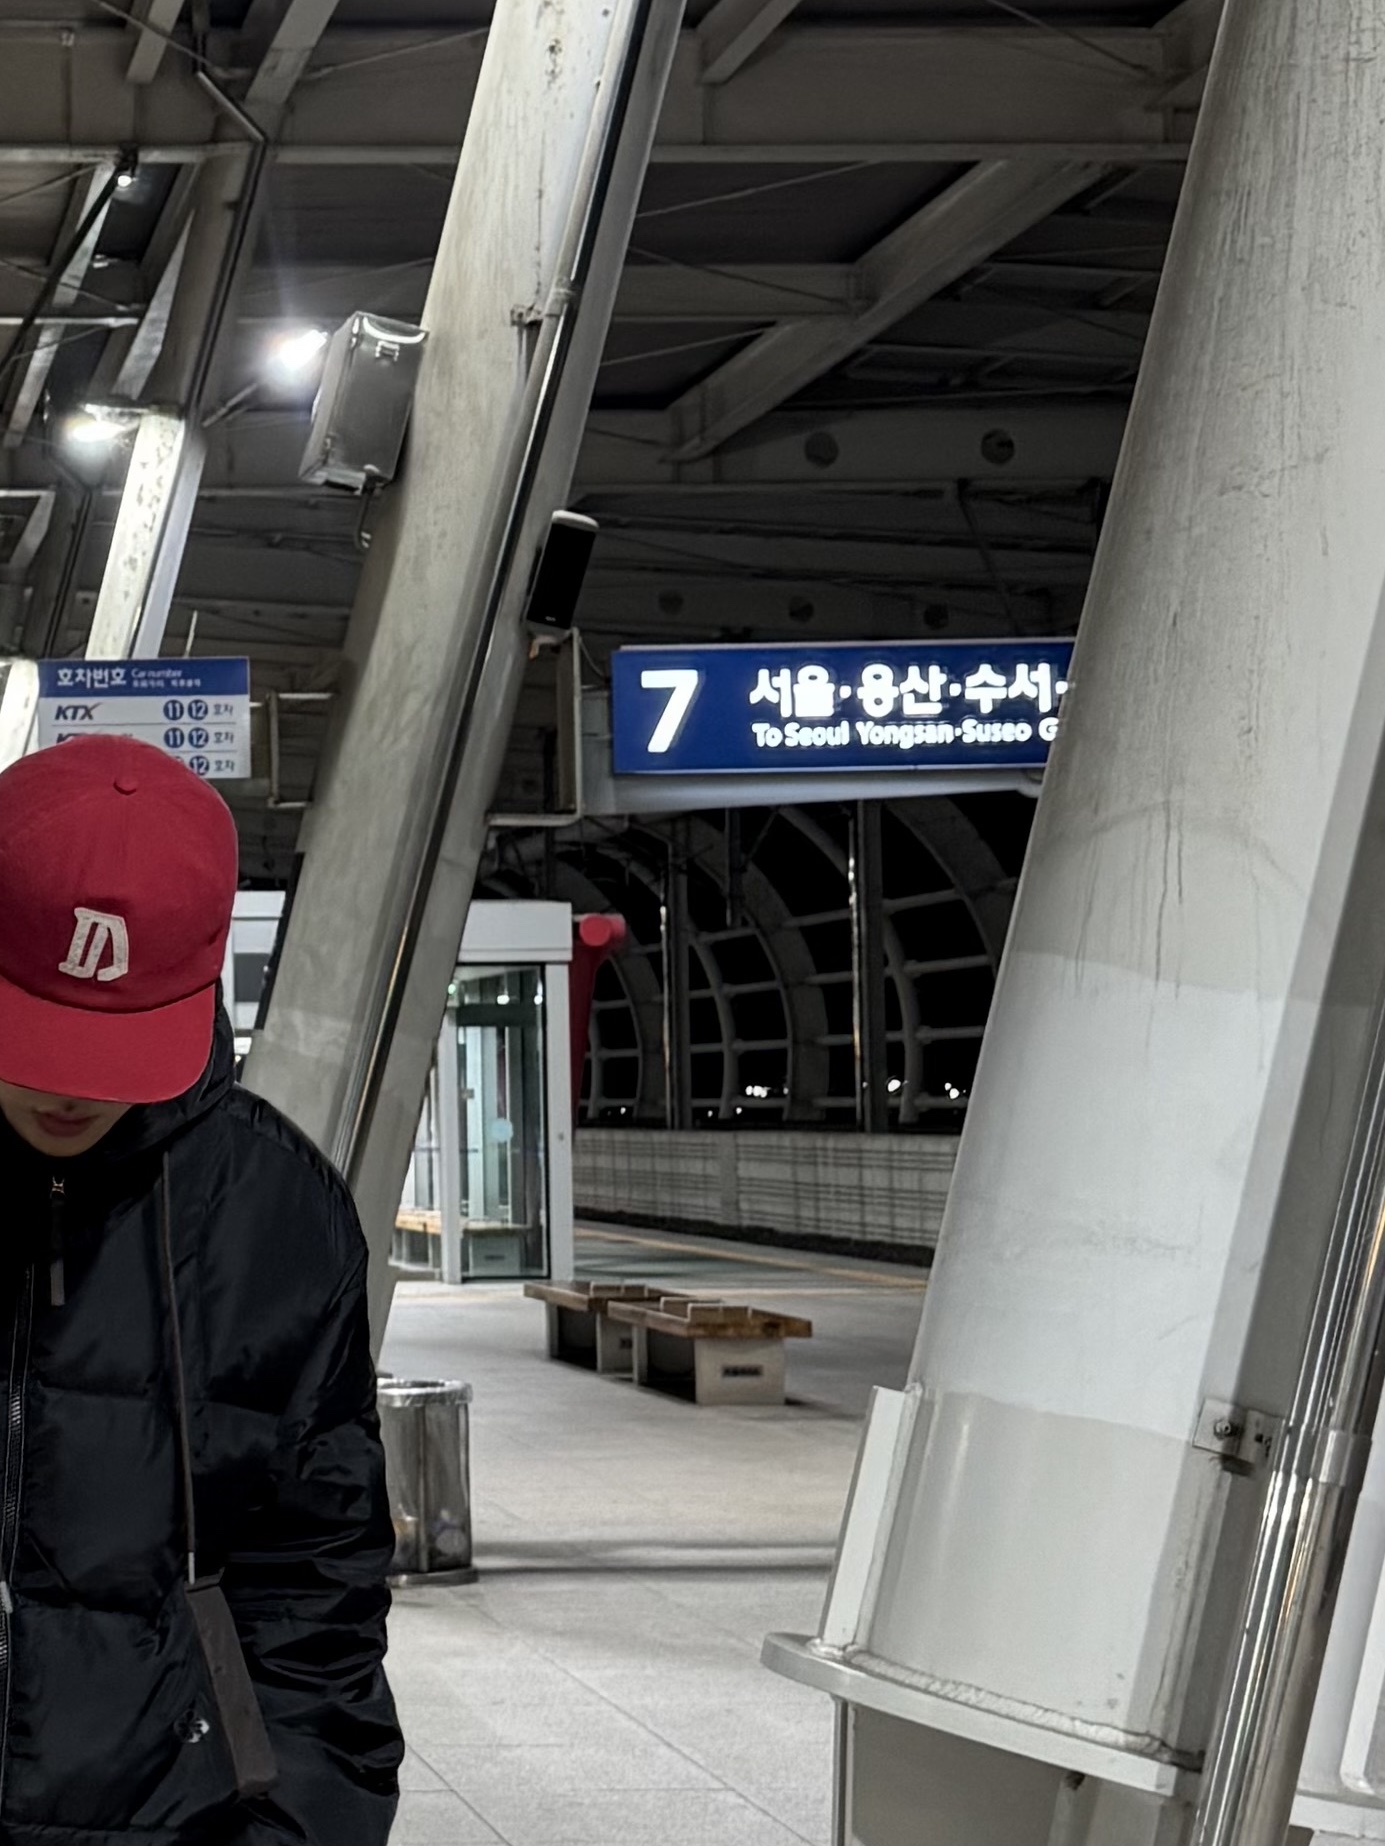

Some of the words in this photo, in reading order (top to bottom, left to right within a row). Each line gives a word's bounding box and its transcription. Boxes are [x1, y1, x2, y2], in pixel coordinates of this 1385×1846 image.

[57, 668, 127, 689] 호차번호
[55, 702, 102, 721] KTX
[166, 701, 183, 719] 11
[190, 701, 207, 719] 12
[640, 668, 699, 753] 7
[166, 729, 183, 747] 11
[190, 729, 207, 747] 12
[751, 722, 782, 747] To
